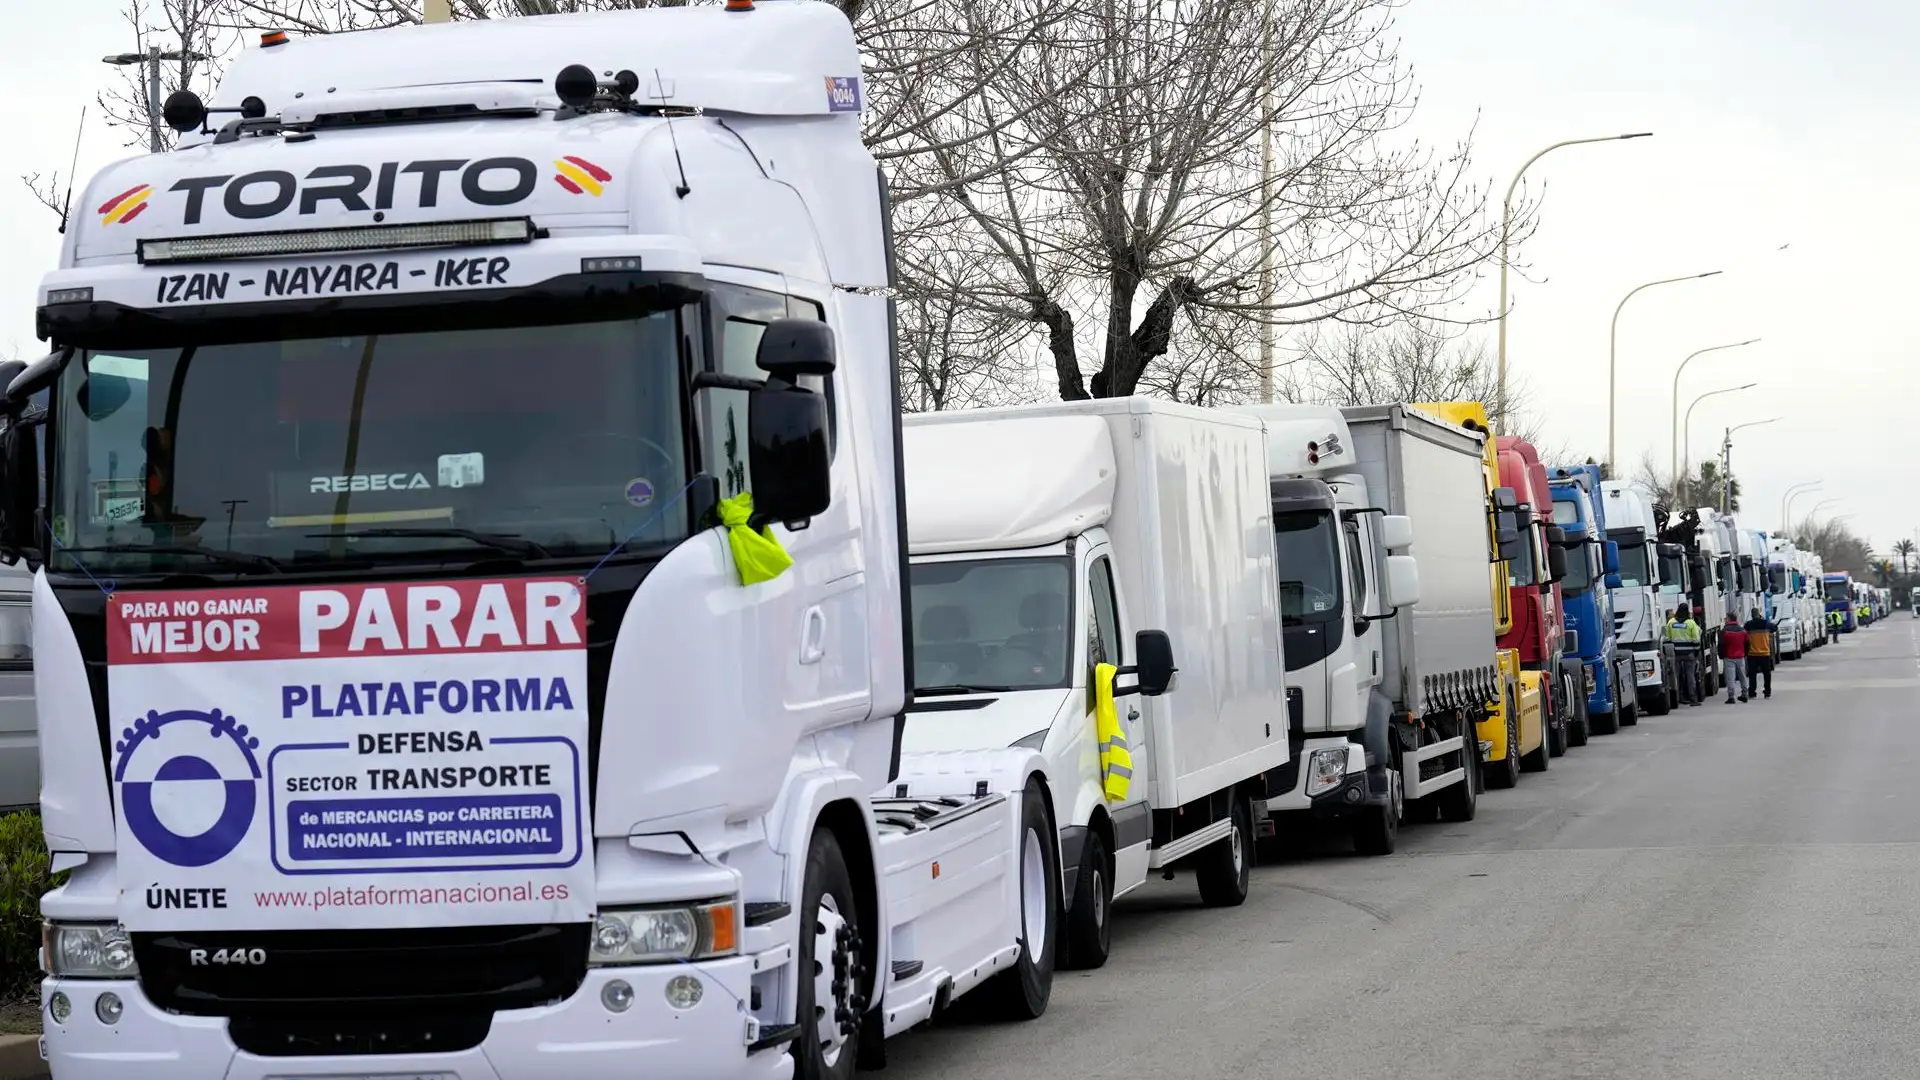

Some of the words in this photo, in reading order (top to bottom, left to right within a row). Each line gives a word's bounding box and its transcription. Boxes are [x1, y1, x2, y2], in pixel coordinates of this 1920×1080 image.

[833, 88, 855, 103] 0046
[168, 156, 537, 224] TORITO
[157, 272, 230, 303] IZAN
[264, 261, 399, 296] NAYARA
[434, 256, 510, 287] IKER
[310, 472, 431, 493] REBECA
[122, 602, 169, 618] PARA
[174, 600, 200, 616] NO
[203, 598, 268, 615] GANAR
[299, 581, 582, 653] PARAR
[131, 618, 260, 654] MEJOR
[282, 677, 574, 719] PLATAFORMA
[357, 730, 484, 755] DEFENSA
[286, 776, 357, 792] SECTOR
[366, 765, 551, 791] TRANSPORTE
[299, 808, 318, 825] de
[322, 809, 424, 825] MERCANCIAS
[428, 809, 454, 827] por
[458, 805, 553, 822] CARRETERA
[303, 832, 391, 849] NACIONAL
[406, 827, 552, 846] INTERNACIONAL
[146, 883, 228, 909] ÚNETE
[254, 881, 569, 911] www.plataformanacional.es
[190, 949, 208, 965] R
[212, 948, 266, 965] 440
